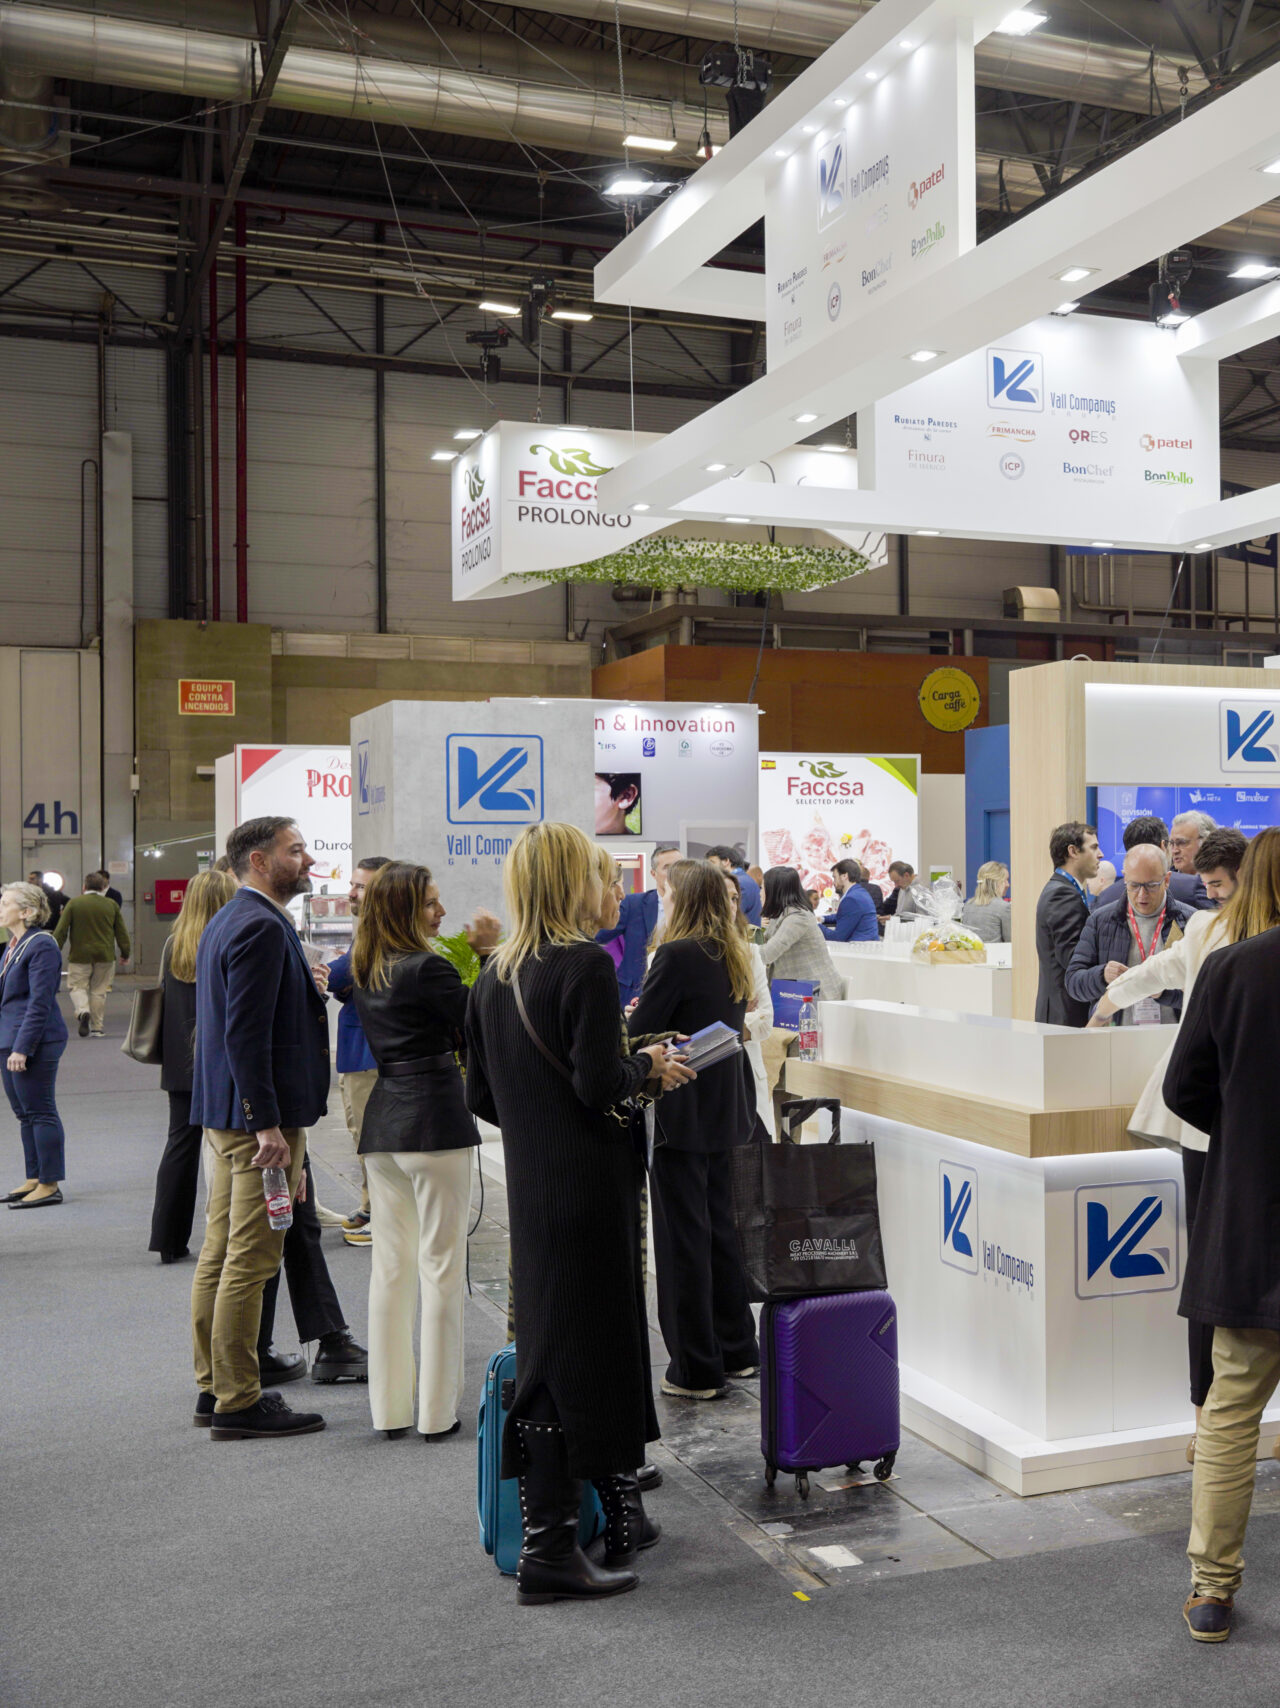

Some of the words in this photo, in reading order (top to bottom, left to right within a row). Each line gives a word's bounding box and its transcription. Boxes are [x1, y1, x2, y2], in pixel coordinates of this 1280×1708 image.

[919, 163, 945, 199] patel
[1050, 392, 1067, 409] Vall
[1069, 393, 1117, 416] Companys
[991, 426, 1037, 436] FRIMANCHA
[1157, 438, 1193, 450] patel
[908, 449, 945, 463] Finura
[1062, 462, 1114, 477] BonChef
[1144, 469, 1194, 485] BonPollo
[518, 470, 598, 501] Facc
[461, 497, 491, 542] Faccsa
[518, 505, 632, 528] PROLONGO
[461, 536, 492, 576] PROLONGO
[191, 683, 223, 692] EQUIPO
[932, 690, 961, 701] Carga
[184, 702, 229, 711] INCENDIOS
[188, 693, 224, 702] CONTRA
[613, 714, 626, 731] &
[634, 715, 735, 733] Innovation
[787, 776, 864, 796] Faccsa
[23, 801, 79, 835] 4h
[446, 834, 471, 856] Vall
[789, 1238, 856, 1252] CAVALLI
[982, 1240, 995, 1272] Vall
[996, 1245, 1034, 1291] Companys
